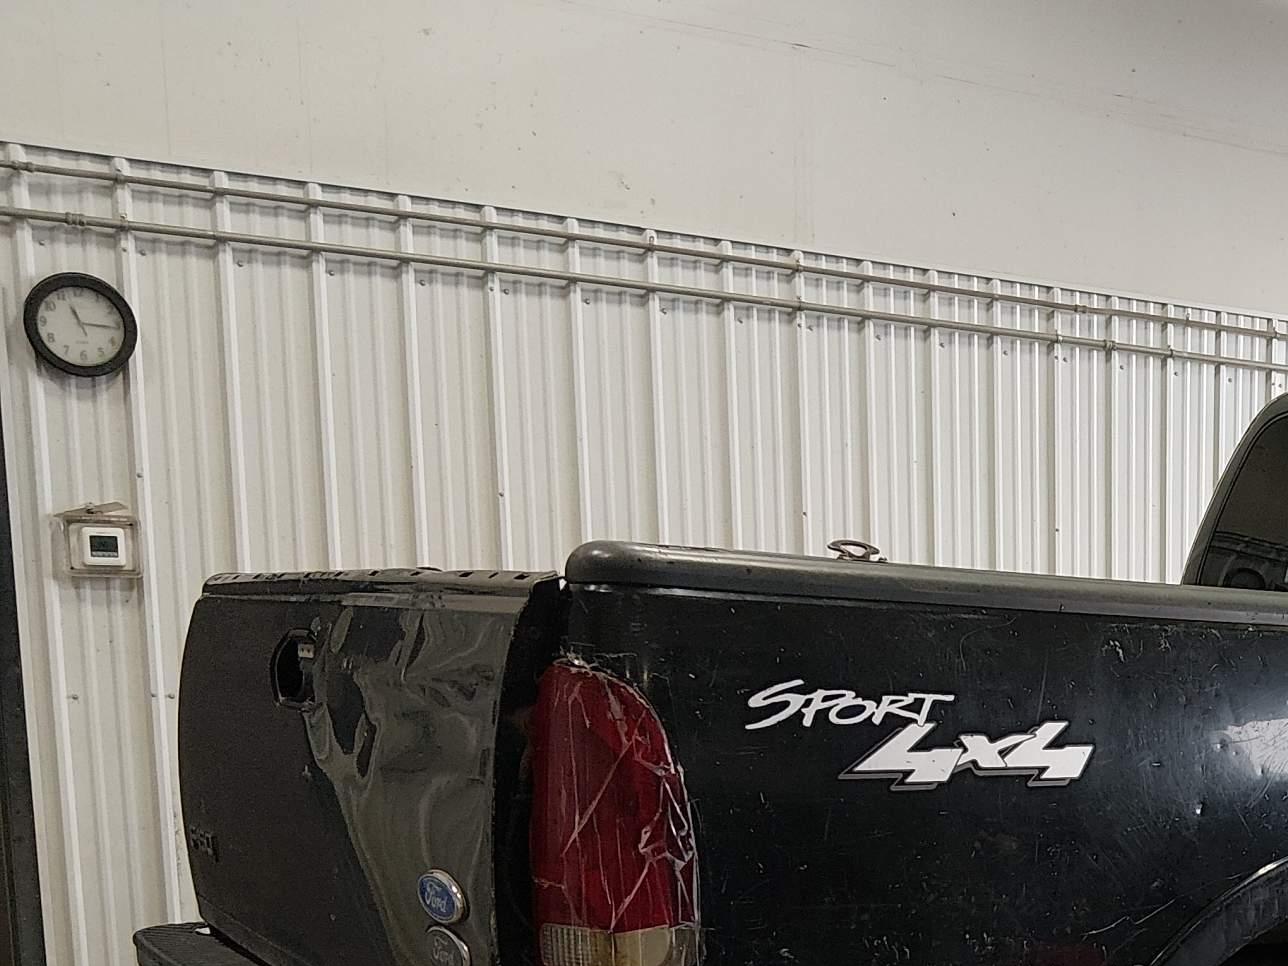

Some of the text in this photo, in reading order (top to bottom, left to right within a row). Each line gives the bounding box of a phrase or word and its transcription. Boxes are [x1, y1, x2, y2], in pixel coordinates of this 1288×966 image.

[44, 300, 56, 312] 10
[39, 315, 48, 327] 9
[46, 332, 55, 343] 8
[63, 344, 70, 355] 7
[97, 347, 105, 358] 5
[80, 350, 88, 361] 6
[745, 679, 955, 729] SPORT
[423, 881, 448, 914] Ford
